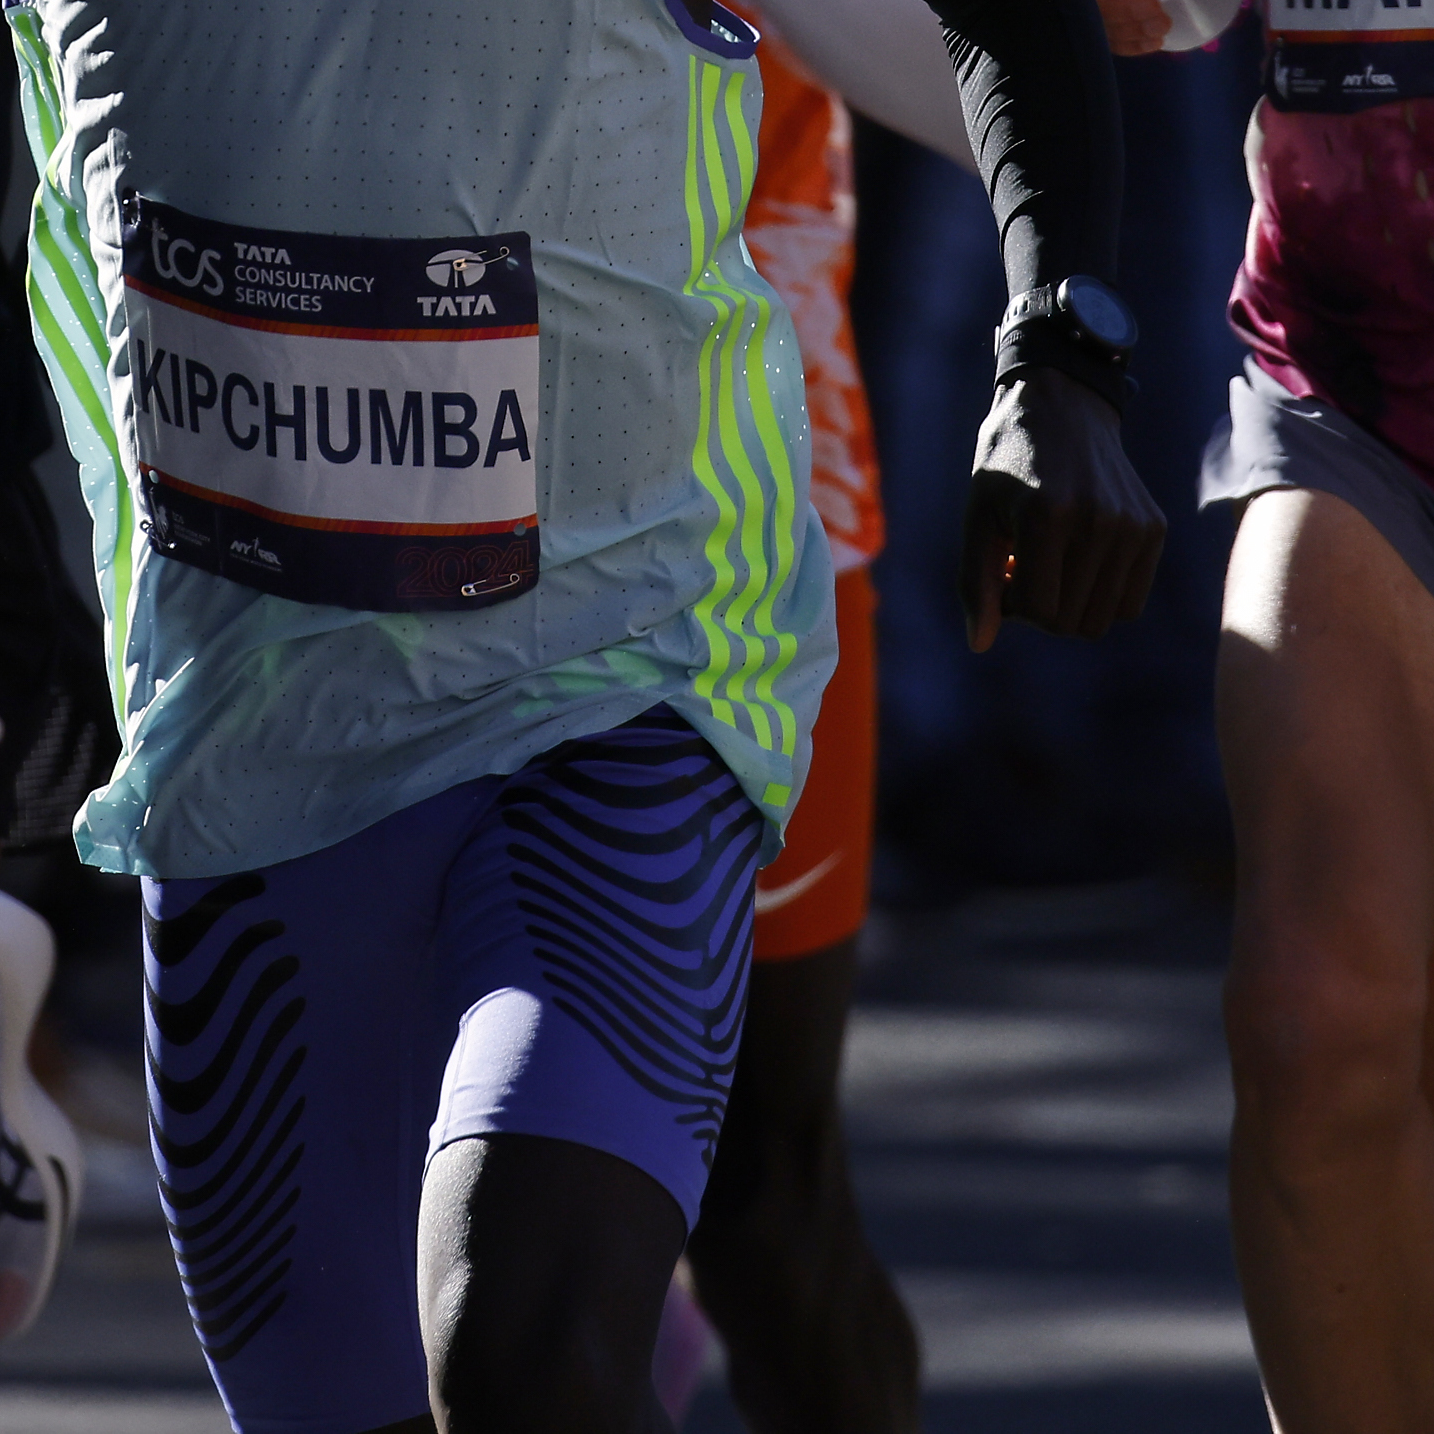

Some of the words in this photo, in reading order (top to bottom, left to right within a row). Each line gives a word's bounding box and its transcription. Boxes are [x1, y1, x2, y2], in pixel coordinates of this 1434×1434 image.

[150, 217, 225, 297] tcs
[233, 242, 292, 265] TATA
[234, 265, 375, 293] CONSULTANCY
[235, 287, 323, 313] SERVICES
[416, 294, 496, 317] TATA
[136, 338, 531, 469] KIPCHUMBA
[396, 540, 533, 598] 2024
